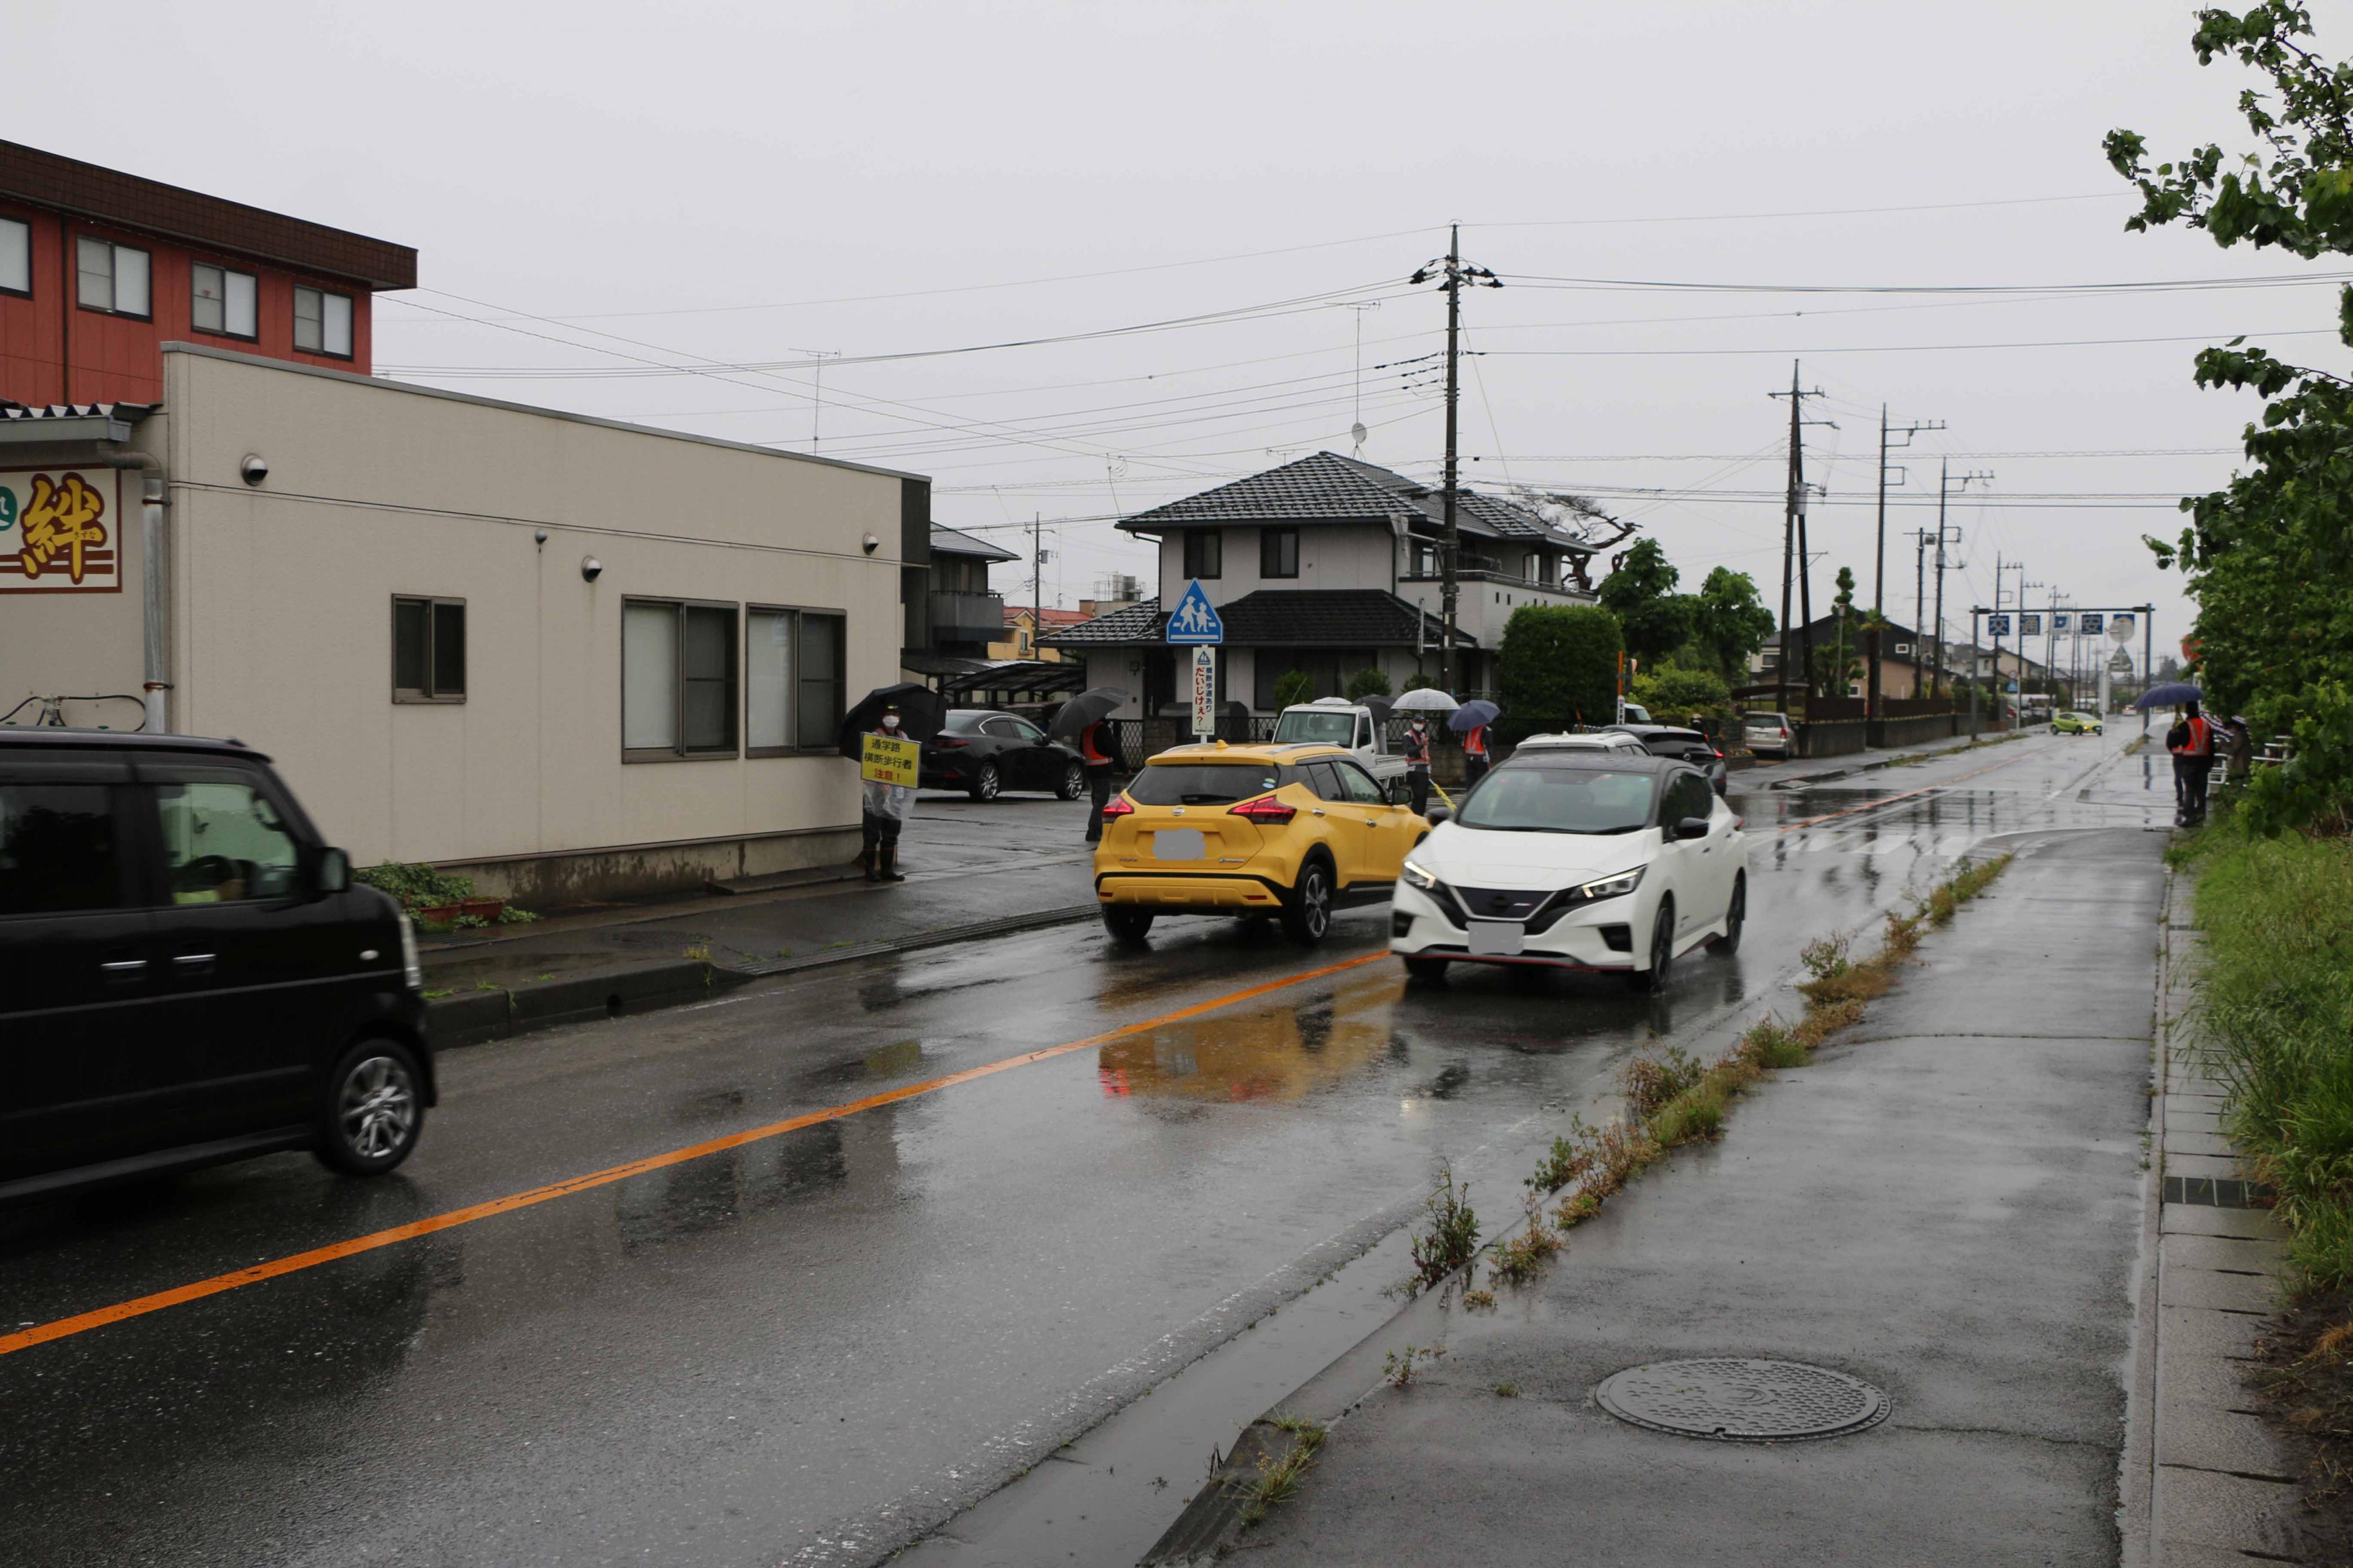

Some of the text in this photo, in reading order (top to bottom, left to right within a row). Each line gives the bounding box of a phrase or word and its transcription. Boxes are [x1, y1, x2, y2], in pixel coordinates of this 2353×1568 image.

[22, 477, 105, 581] 絆
[871, 739, 901, 752] 通学路
[865, 752, 911, 770] 横断歩行者
[875, 768, 900, 781] 注意！
